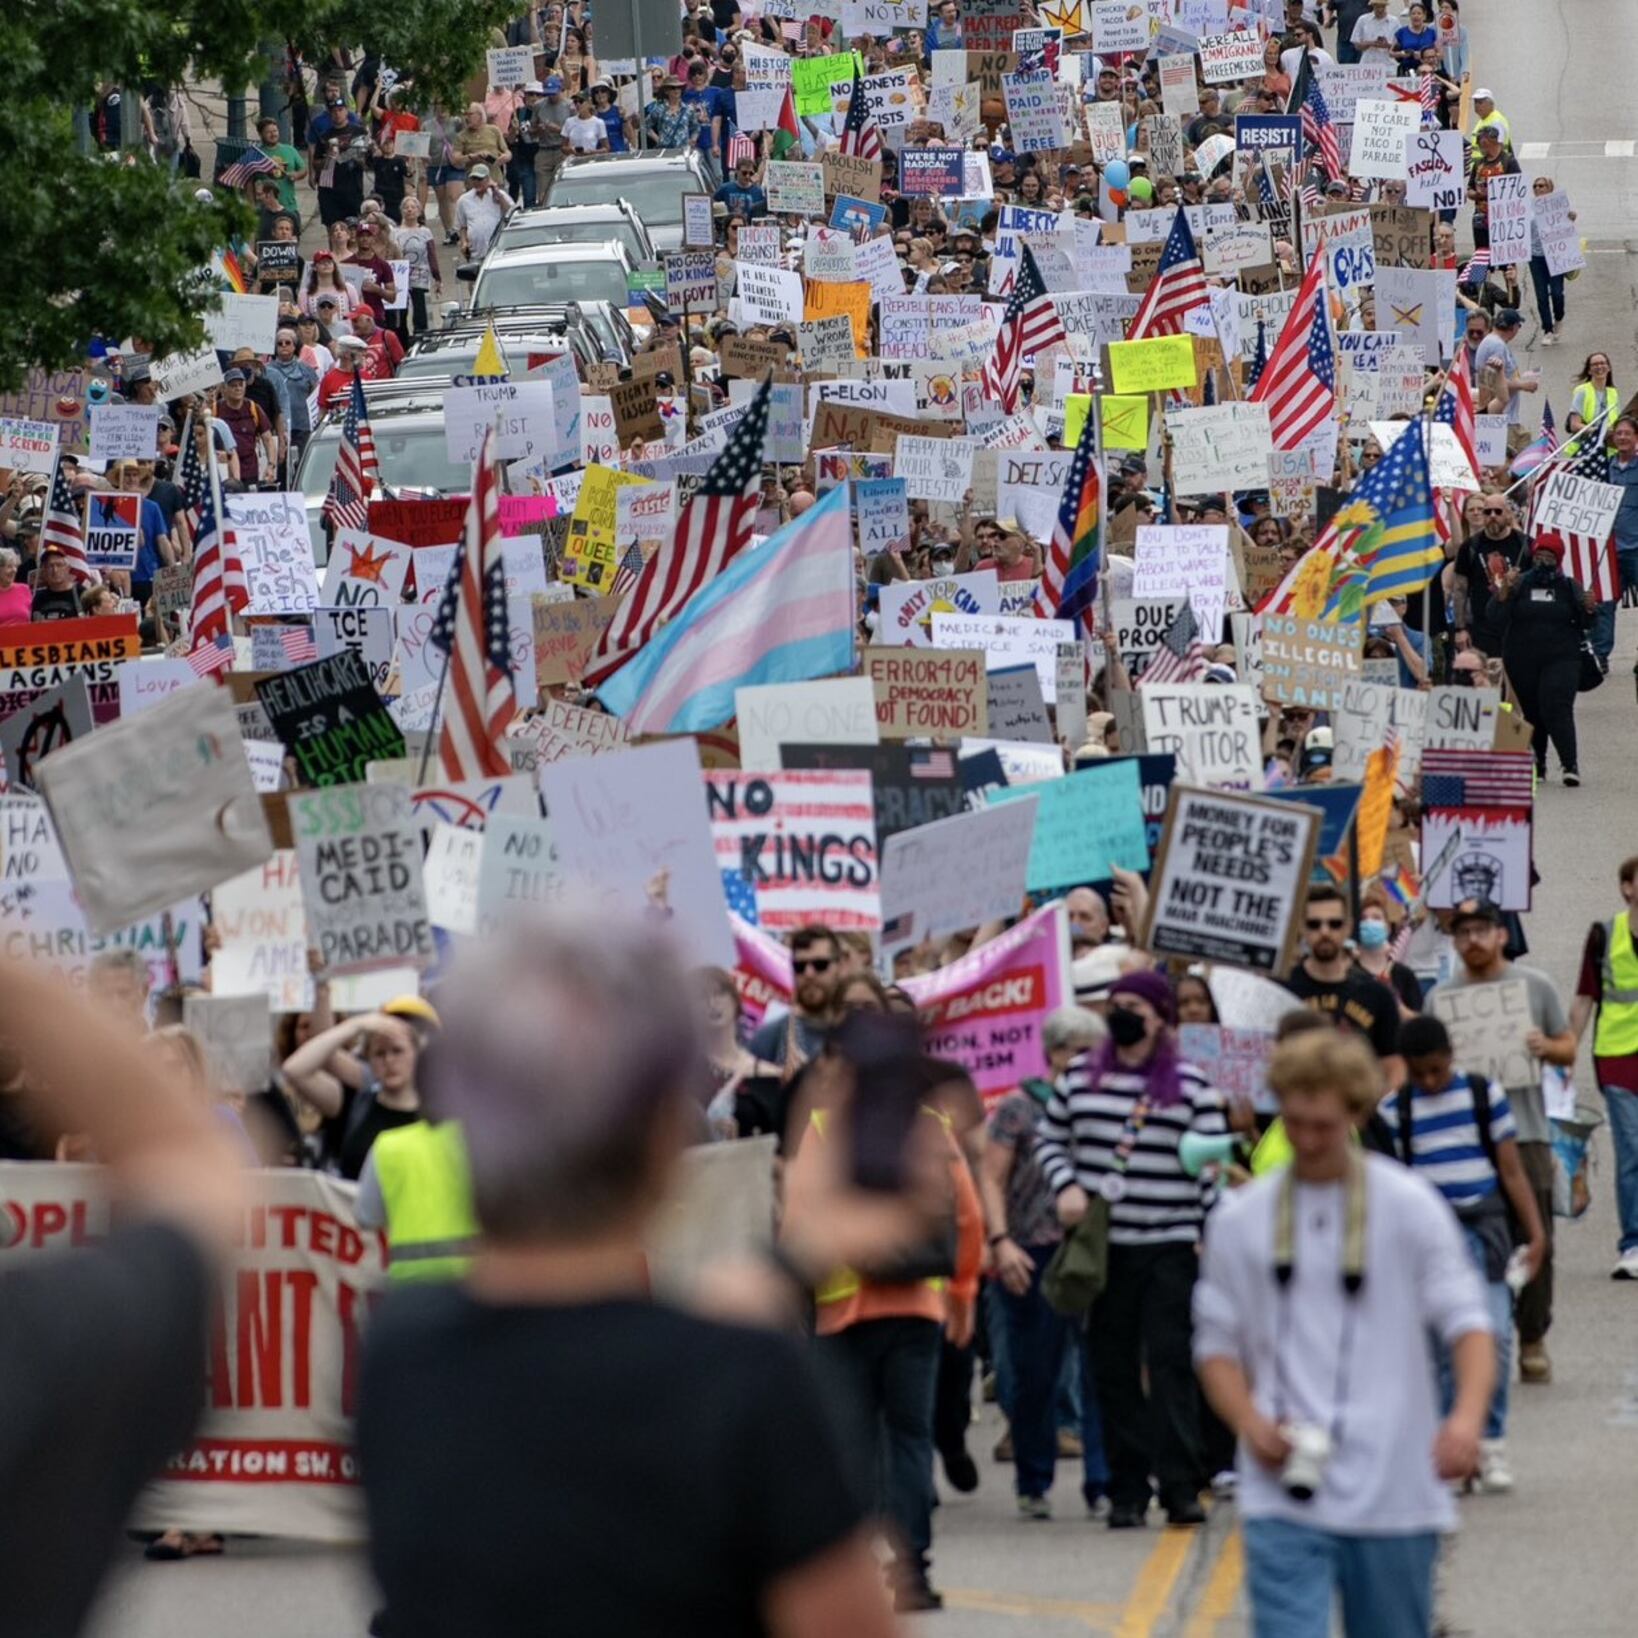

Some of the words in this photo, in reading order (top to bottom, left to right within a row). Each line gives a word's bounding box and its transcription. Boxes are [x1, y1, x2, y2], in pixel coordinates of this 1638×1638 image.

[980, 54, 1008, 71] NO
[1004, 70, 1051, 87] TRUMP
[1009, 95, 1042, 111] PAID
[1382, 114, 1410, 126] CARE
[1149, 130, 1179, 146] FAUX
[1240, 127, 1298, 146] RESIST!
[1370, 126, 1392, 137] NOT
[1022, 136, 1056, 149] FREE
[821, 151, 874, 176] ABOLISH
[904, 152, 935, 162] WE'RE
[938, 152, 960, 161] NOT
[904, 160, 950, 169] RADICAL.
[839, 173, 863, 185] ICE
[904, 169, 925, 177] WE
[926, 168, 947, 177] JUST
[904, 176, 959, 184] REMEMBER
[829, 181, 865, 199] NOW
[1489, 173, 1528, 201] 1776
[1433, 187, 1462, 208] NO!
[1000, 206, 1059, 230] LIBERTY
[1303, 211, 1370, 237] TYRANNY
[1490, 218, 1526, 244] 2025
[262, 245, 296, 258] DOWN
[667, 256, 684, 269] NO
[684, 252, 713, 267] GODS
[739, 244, 780, 260] AGAINST
[668, 269, 684, 284] NO
[684, 266, 716, 281] KINGS
[753, 271, 767, 282] ARE
[769, 274, 782, 285] ALL
[668, 293, 682, 306] IN
[743, 283, 776, 297] DREAMERS
[733, 339, 746, 351] NO
[748, 341, 779, 355] KINGS
[816, 329, 850, 345] WRONG
[1338, 334, 1362, 351] YOU
[728, 350, 758, 362] SINCE
[882, 363, 912, 380] WE
[475, 388, 519, 401] TRUMP
[616, 382, 649, 405] FIGHT
[820, 384, 888, 402] F-ELON
[587, 413, 612, 428] NO
[705, 405, 750, 431] REJECTING
[9, 436, 51, 452] SCREWED
[901, 437, 938, 457] HAPPY
[900, 457, 932, 476] YOUR
[1003, 459, 1041, 486] DEI
[863, 485, 900, 498] Liberty
[1549, 474, 1575, 501] NO
[1577, 481, 1621, 513] KINGS
[225, 494, 305, 527] Smash
[87, 532, 136, 552] NOPE
[866, 526, 904, 541] ALL
[249, 534, 295, 564] The
[571, 536, 616, 562] QUEE
[1137, 545, 1168, 560] GET
[1136, 562, 1175, 577] ABOUT
[245, 568, 310, 597] Fash
[283, 595, 316, 611] ICE
[897, 589, 927, 628] ONLY
[925, 582, 959, 599] YOU
[329, 609, 368, 640] ICE
[1135, 604, 1175, 627] DUE
[1033, 626, 1065, 639] AND
[1266, 616, 1297, 636] NO
[1306, 621, 1361, 649] ONES
[0, 638, 127, 669] LESBIANS
[1265, 640, 1359, 671] ILLEGAL
[135, 673, 181, 694] Love
[257, 653, 369, 718] HEALTHCARE
[889, 686, 974, 704] DEMOCRACY
[296, 713, 328, 739] IS
[337, 704, 355, 723] A
[906, 702, 979, 731] FOUND!
[1436, 693, 1482, 733] SIN
[294, 707, 398, 780] HUMAN
[704, 776, 776, 820] NO
[1187, 801, 1256, 831] MONEY
[1261, 814, 1299, 838] FOR
[1180, 821, 1295, 866] PEOPLE'S
[5, 851, 39, 879] NO
[1192, 849, 1272, 886] NEEDS
[319, 863, 411, 904] CAID
[1171, 876, 1225, 909] NOT
[1232, 887, 1281, 923] THE
[1164, 904, 1198, 923] WAR
[1203, 910, 1277, 937] MACHINE!
[320, 919, 432, 963] PARADE
[945, 974, 1037, 1019] BACK!
[1441, 983, 1527, 1026] ICE
[990, 1024, 1034, 1047] NOT
